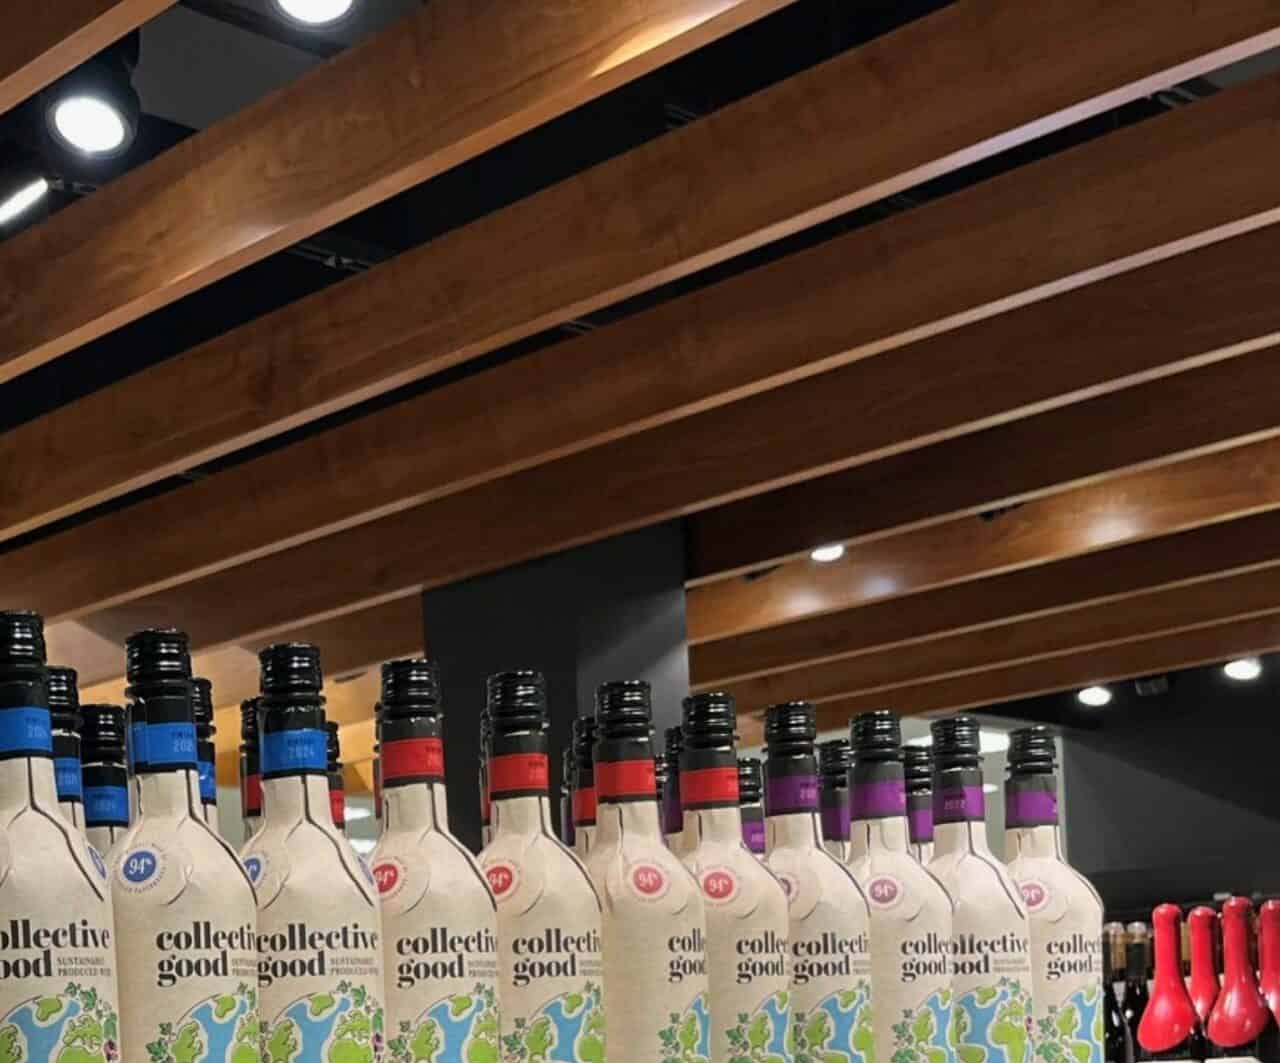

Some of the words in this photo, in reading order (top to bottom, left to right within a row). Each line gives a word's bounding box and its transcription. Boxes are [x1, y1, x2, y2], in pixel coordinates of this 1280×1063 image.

[156, 921, 256, 951] collectiv
[256, 923, 378, 952] collective
[396, 927, 496, 955] collectiv
[736, 930, 786, 955] colle
[792, 931, 868, 957] collecti
[157, 950, 229, 988] good
[257, 950, 326, 988] good
[397, 954, 464, 989] good
[513, 954, 576, 988] good
[736, 955, 784, 985] good
[793, 957, 850, 985] good
[901, 955, 946, 983] good
[953, 955, 990, 975] ood
[1046, 955, 1092, 980] good
